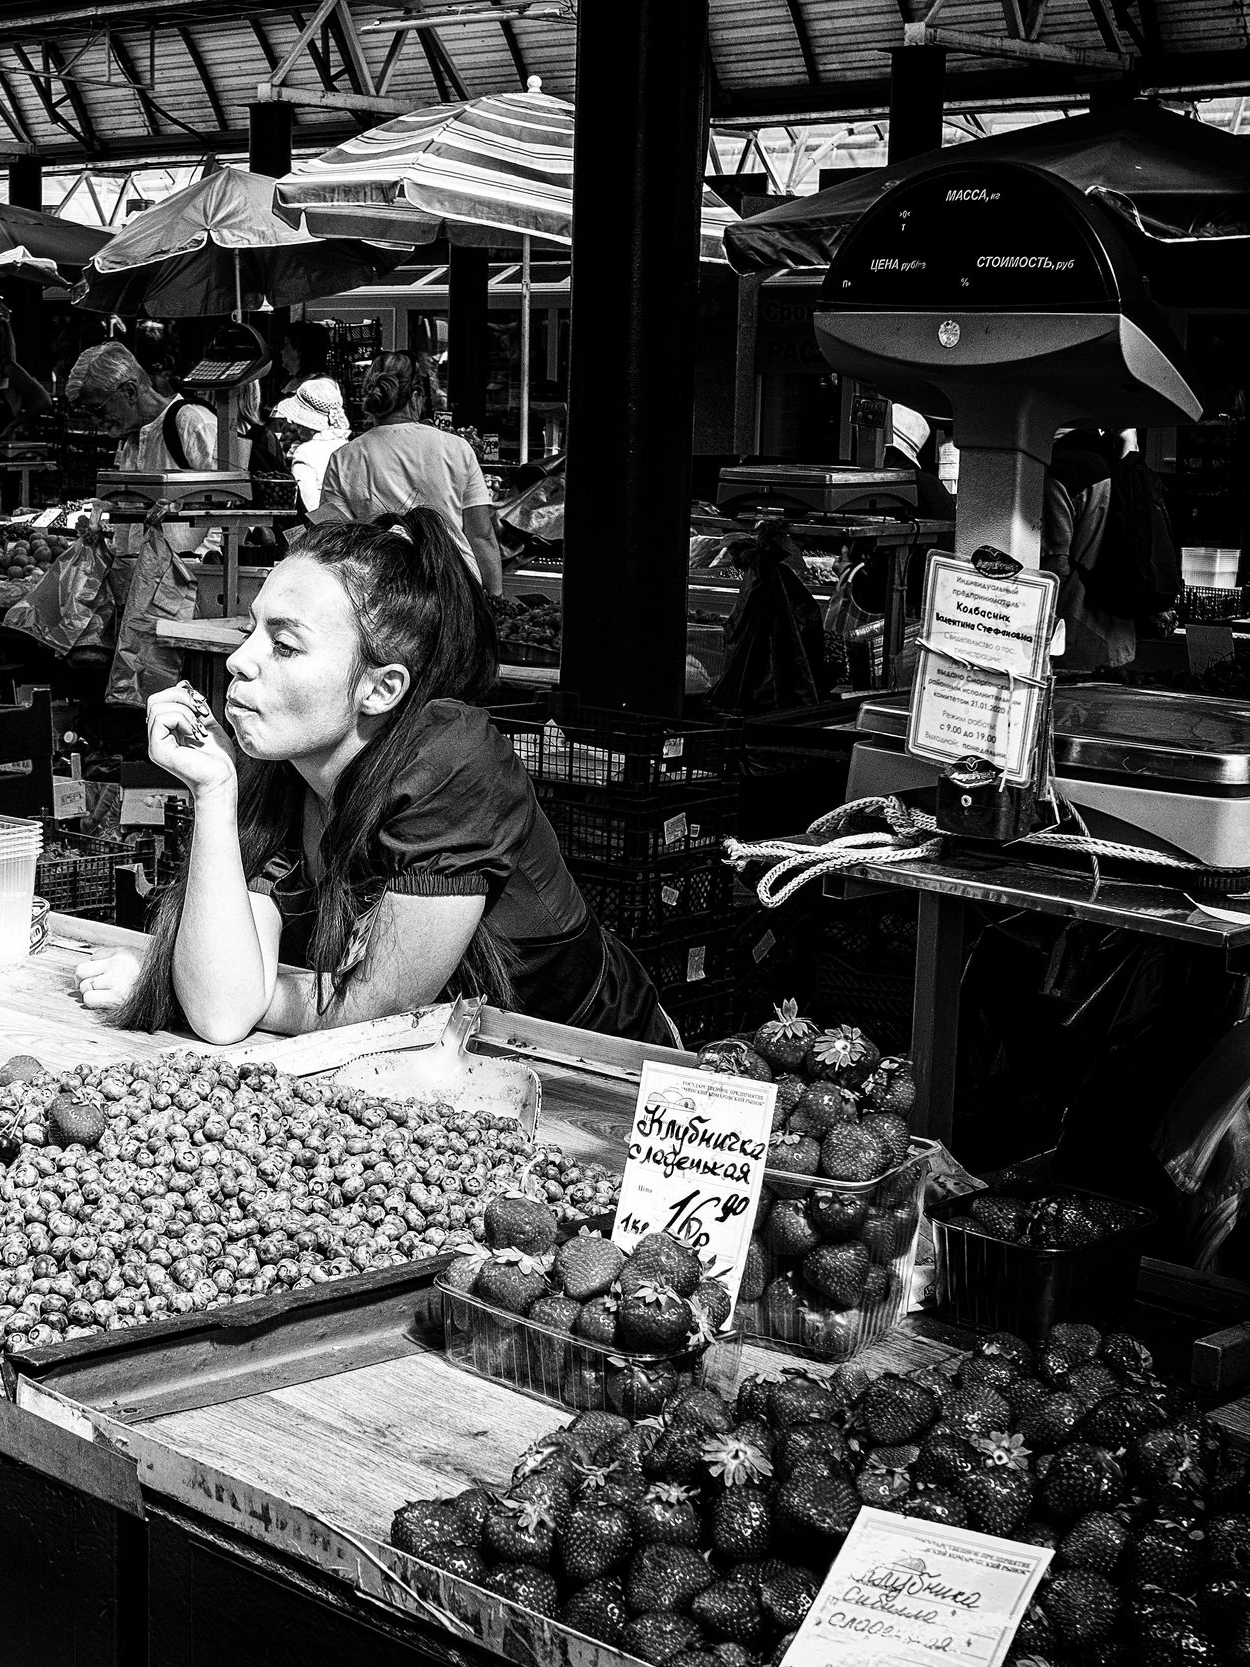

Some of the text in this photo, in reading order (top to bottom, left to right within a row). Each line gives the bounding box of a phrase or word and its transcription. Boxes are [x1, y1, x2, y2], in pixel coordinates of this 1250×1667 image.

[870, 258, 899, 272] ЦЕНА
[956, 575, 1019, 595] Индивидуальный
[952, 588, 1019, 608] предприниматель
[956, 601, 1011, 623] Колбасник
[935, 611, 1033, 643] Валентина Стефановна
[928, 678, 961, 693] районным
[937, 668, 1010, 691] выдано Сморгонски
[970, 700, 1006, 714] 21.01.2020
[939, 723, 997, 744] с 9.00 до 19.00
[636, 1104, 767, 1160] Клубничка
[627, 1143, 751, 1185] сладенькая
[637, 1184, 653, 1194] Цена
[662, 1189, 721, 1240] 16
